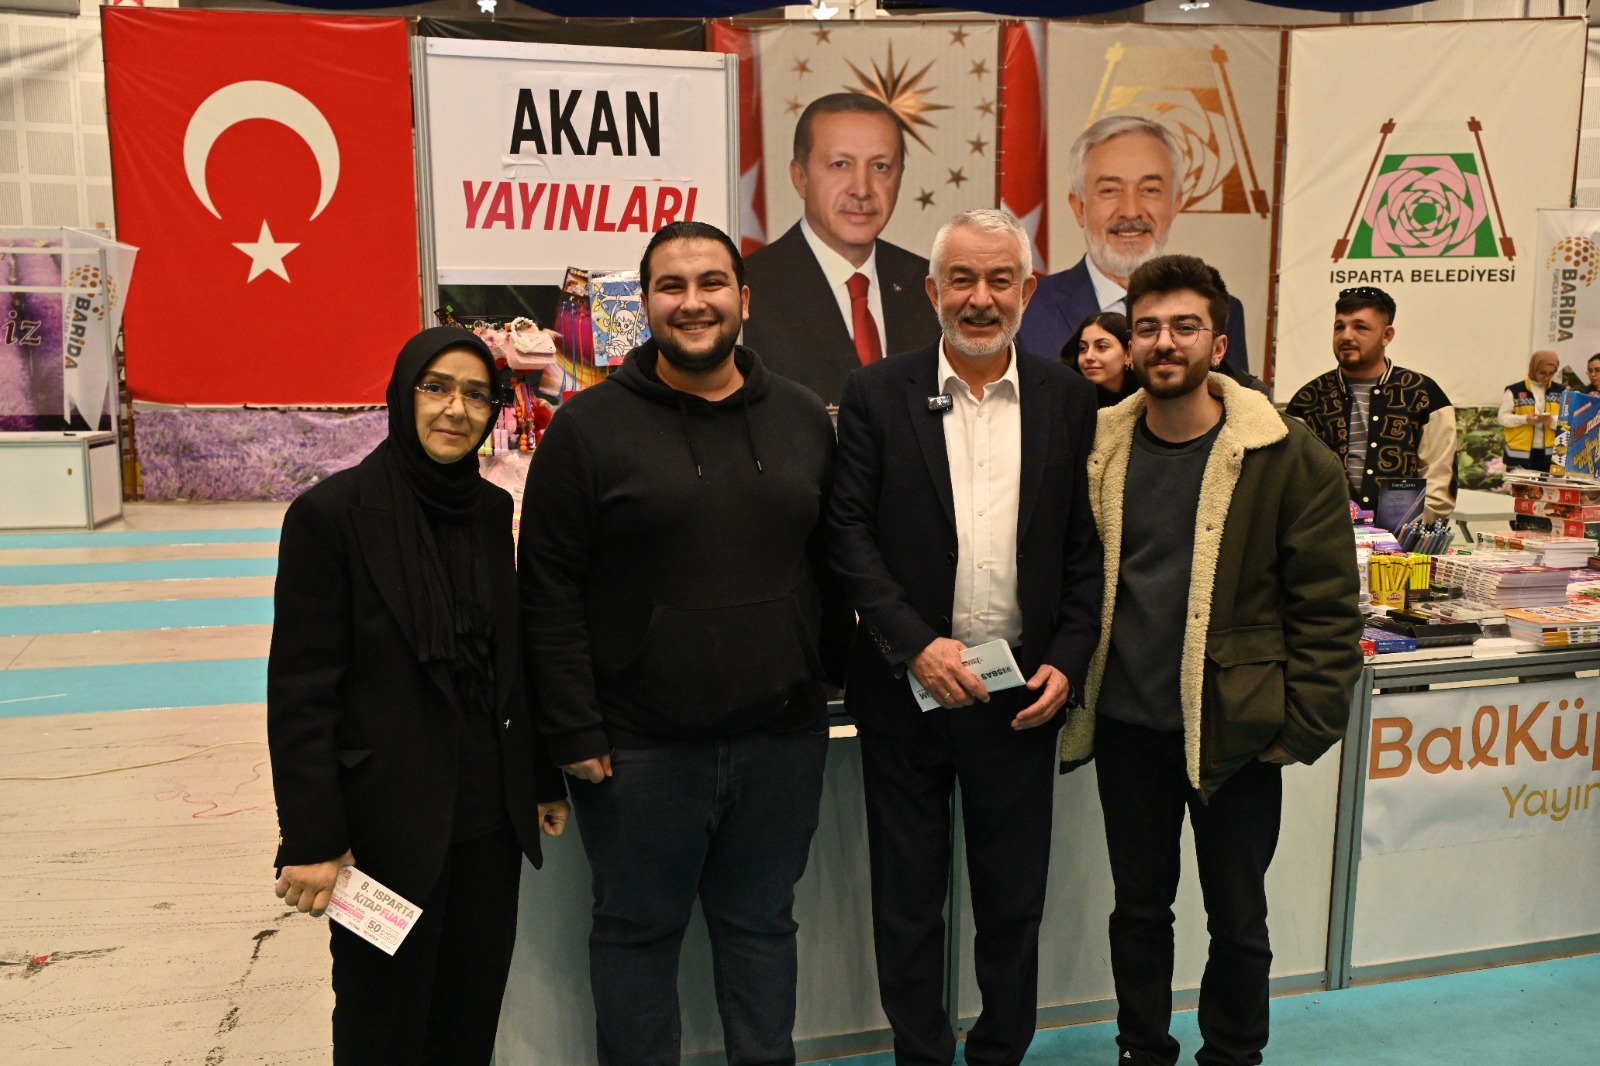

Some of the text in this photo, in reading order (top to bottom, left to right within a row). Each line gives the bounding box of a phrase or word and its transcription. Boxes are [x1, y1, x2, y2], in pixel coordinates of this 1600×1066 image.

[509, 88, 661, 157] AKAN
[462, 180, 698, 233] YAYINLARI
[1330, 265, 1515, 284] ISPARTA BELEDİYESİ
[1557, 268, 1577, 342] BARİDA
[65, 296, 91, 370] BARİDA
[360, 881, 369, 893] 8.
[372, 889, 415, 920] ISPARTA
[367, 919, 381, 933] 50
